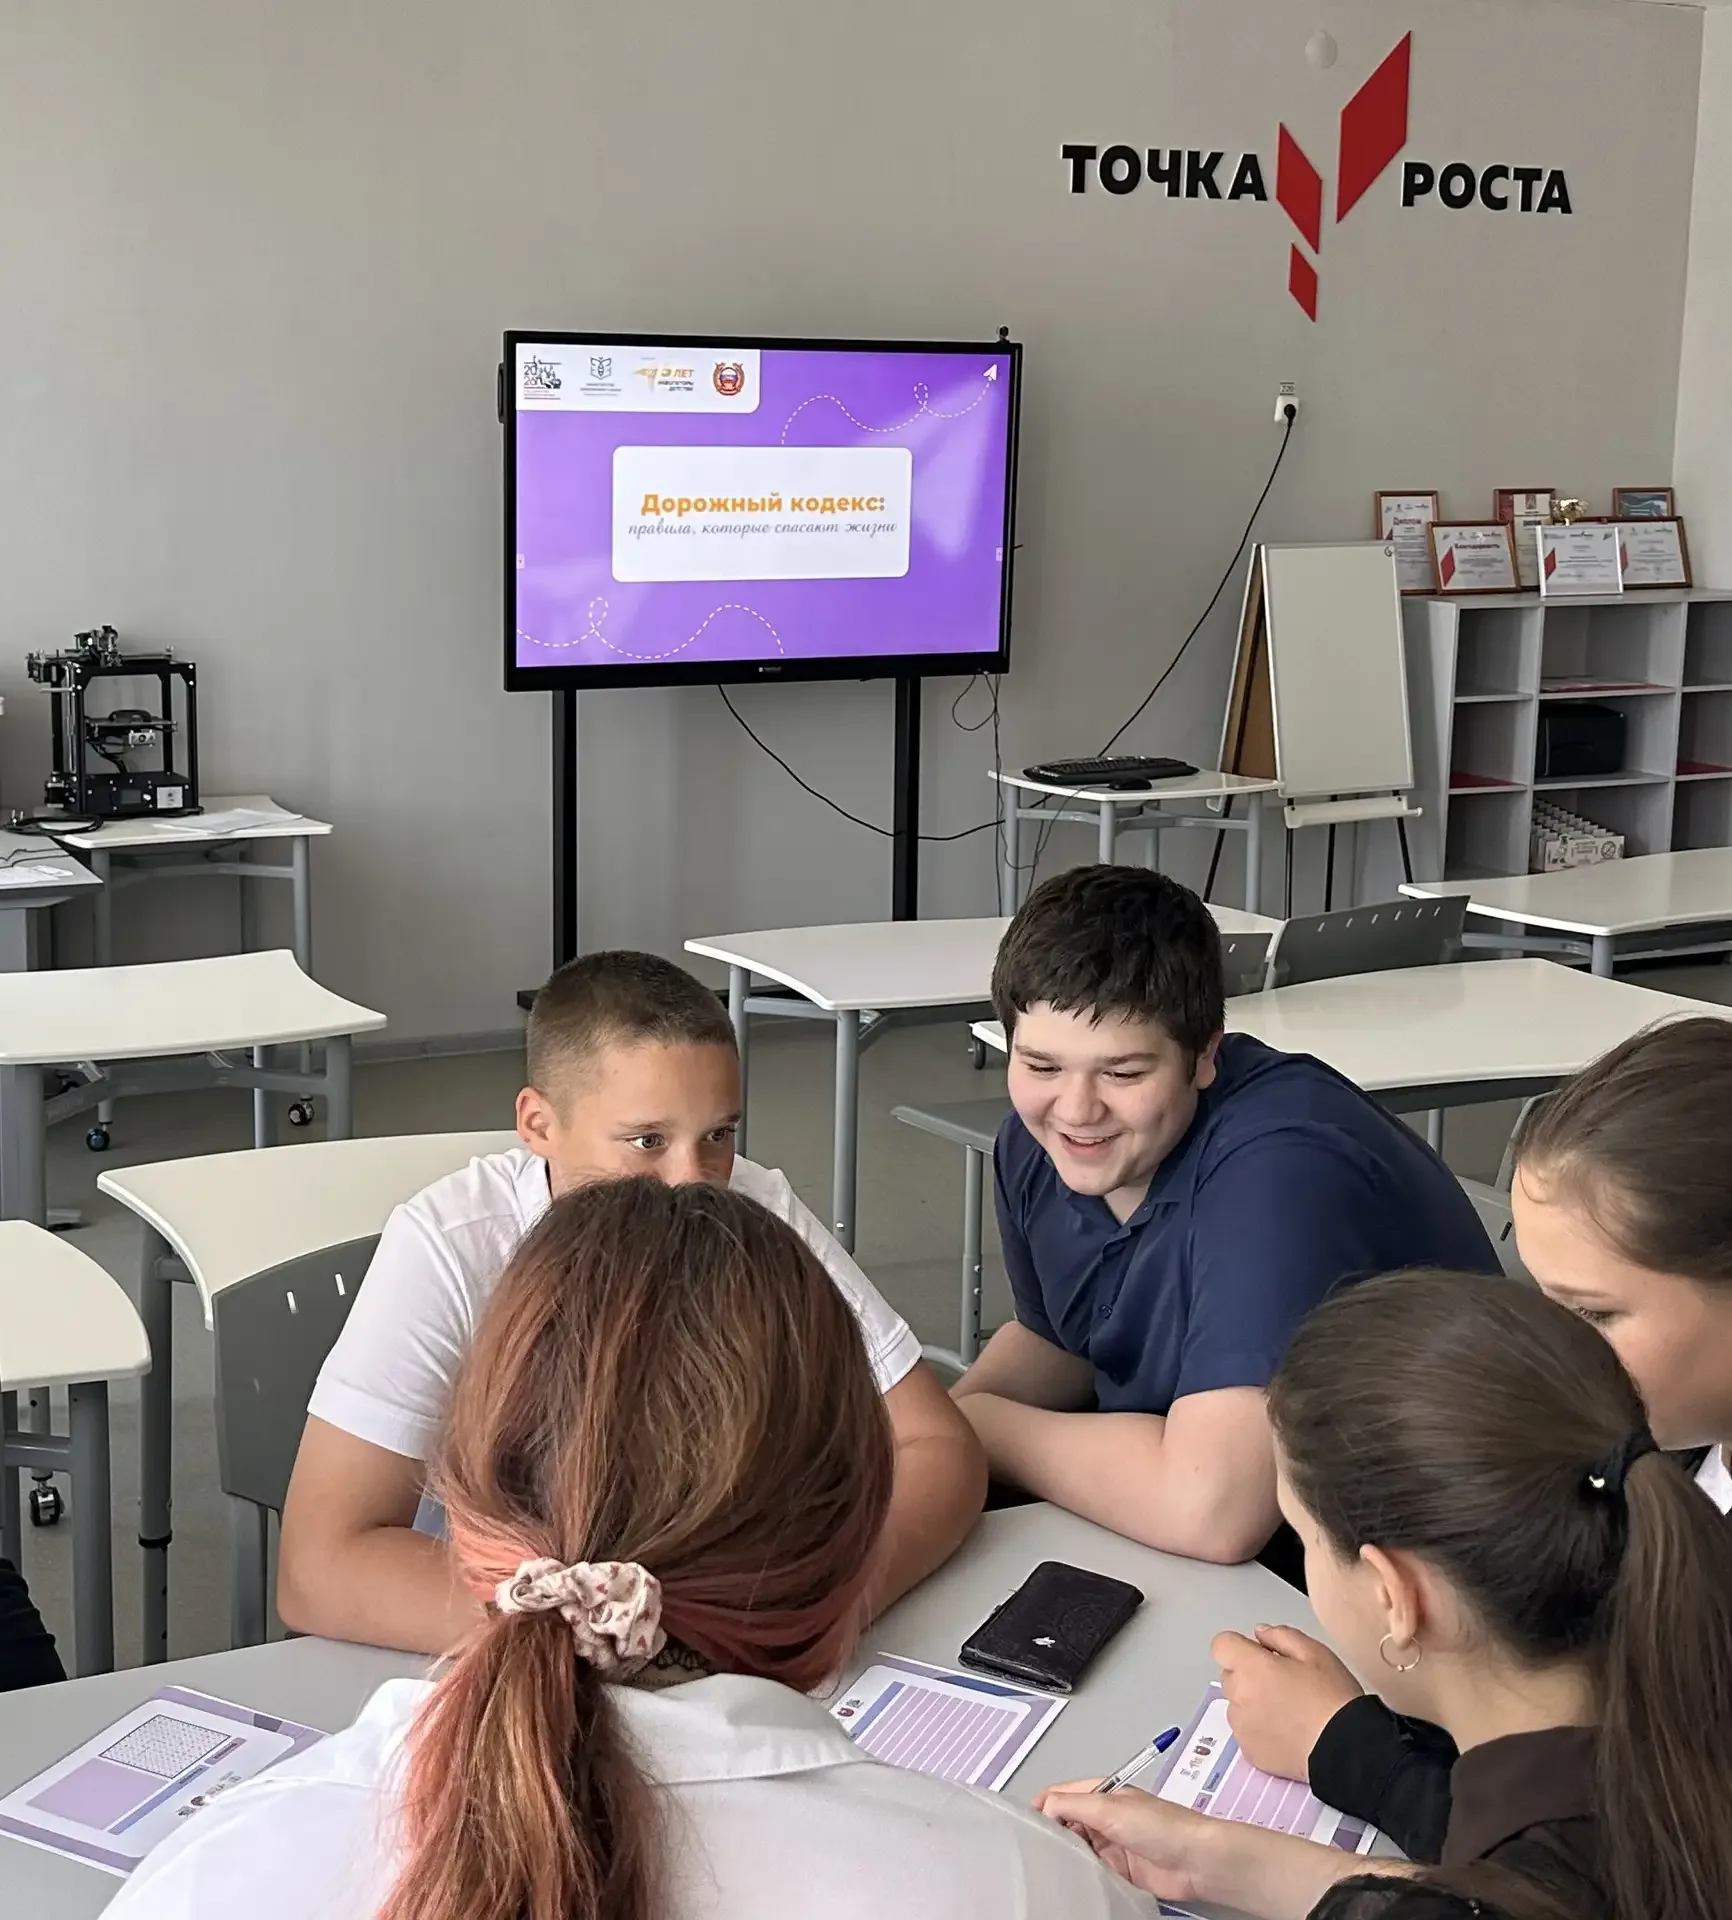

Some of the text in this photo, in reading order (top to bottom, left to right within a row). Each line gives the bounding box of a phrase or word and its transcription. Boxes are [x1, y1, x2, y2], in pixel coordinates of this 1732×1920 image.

[1061, 143, 1573, 214] ТОЧКА РОСТА
[641, 492, 885, 517] Дорожный кодекс:
[627, 517, 898, 540] правила, которые спасают жизни
